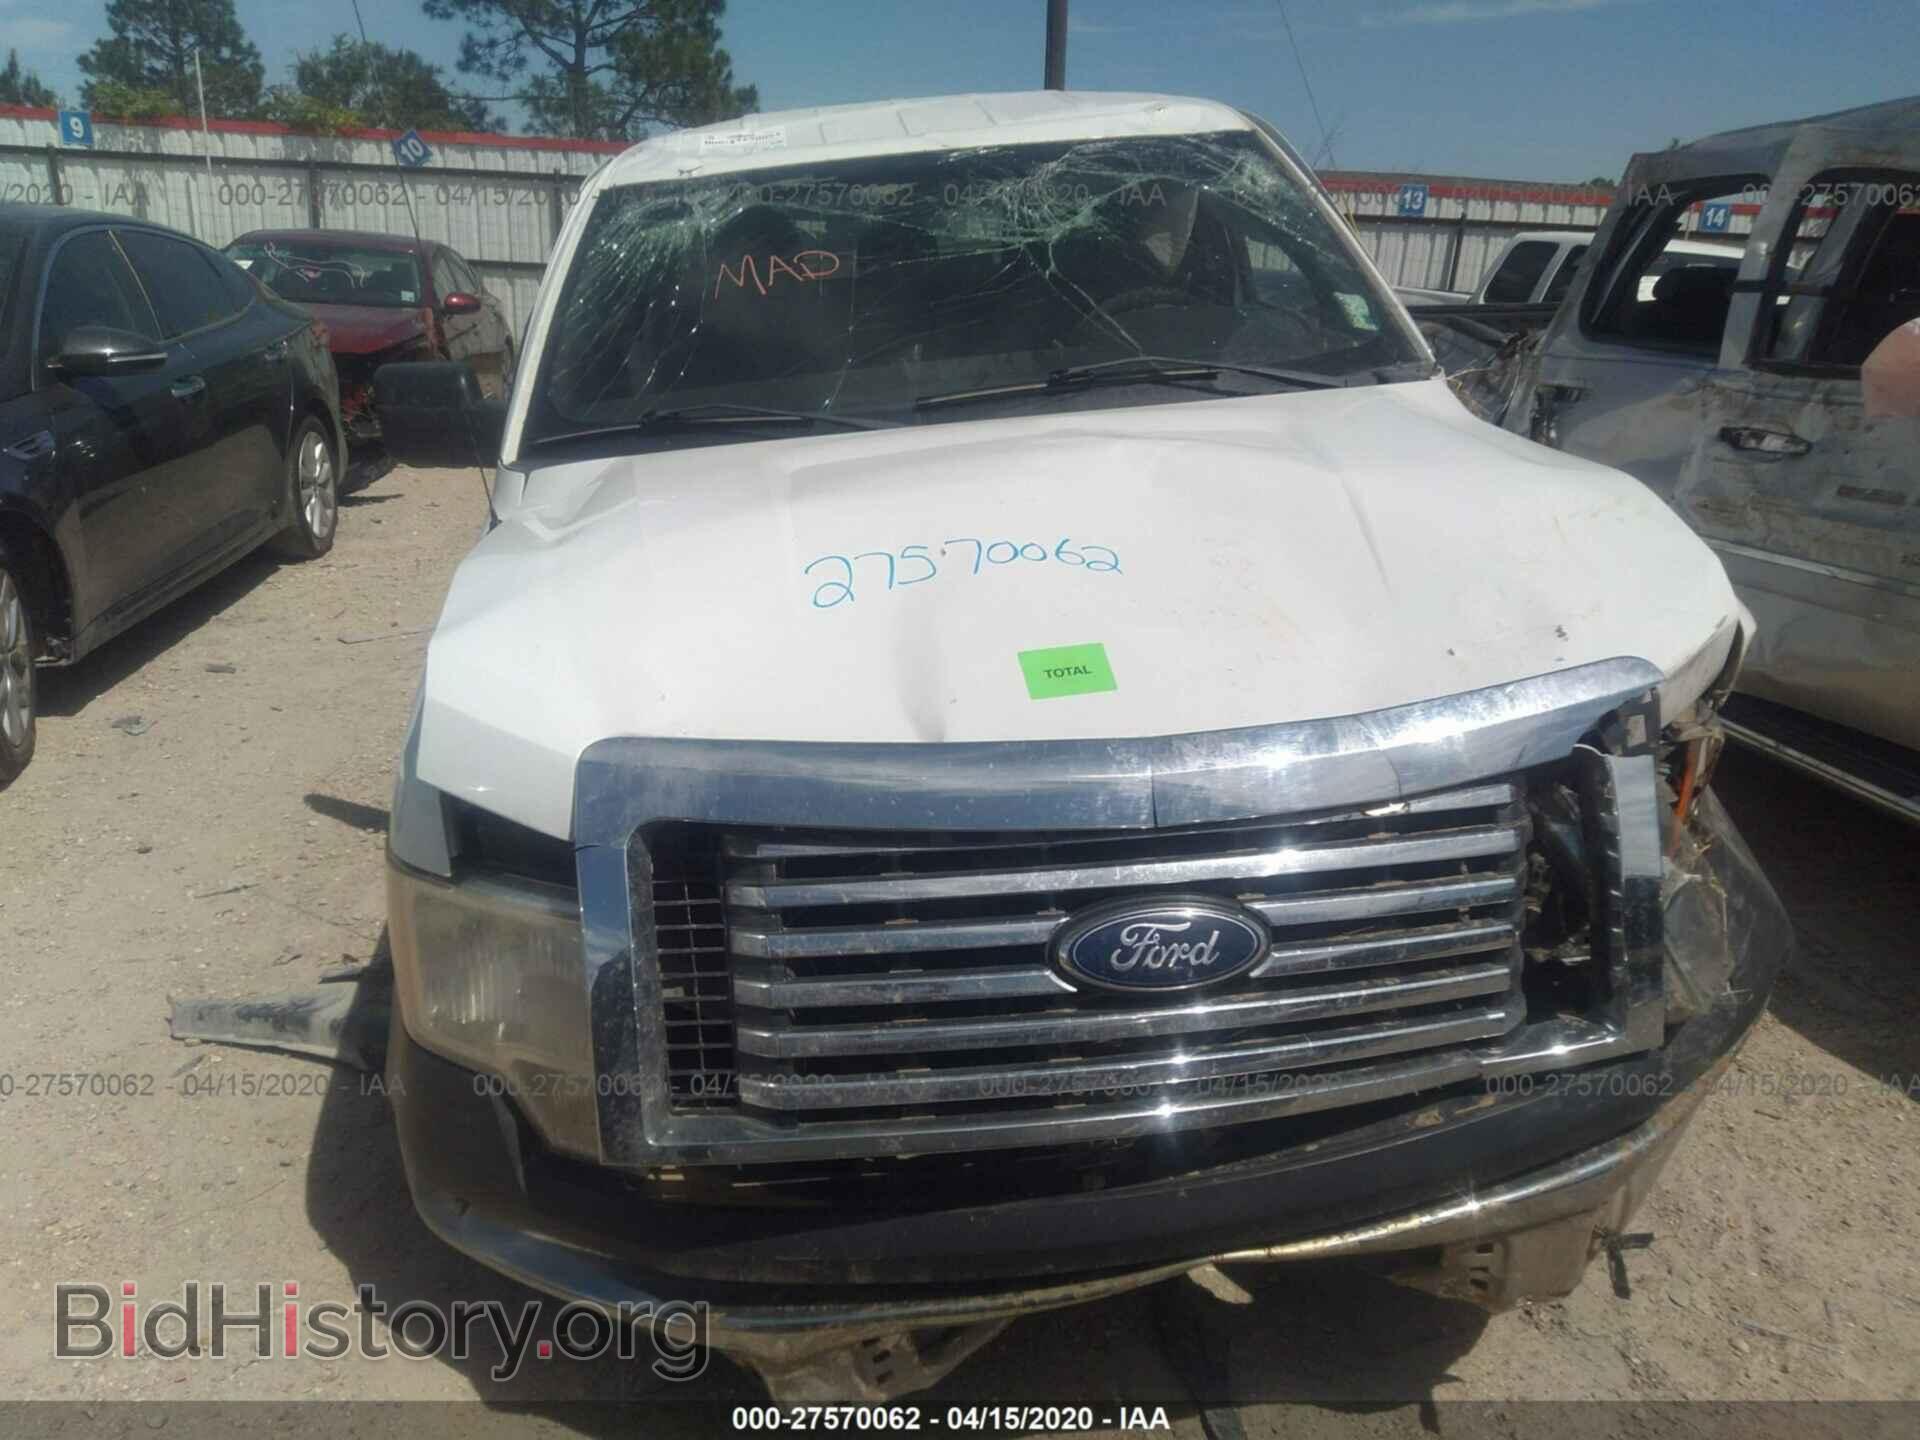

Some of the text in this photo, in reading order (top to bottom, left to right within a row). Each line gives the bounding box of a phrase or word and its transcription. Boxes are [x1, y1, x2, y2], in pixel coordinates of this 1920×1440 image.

[70, 116, 84, 138] 9
[400, 139, 424, 162] 10
[1403, 190, 1425, 210] 13
[1706, 207, 1726, 227] 14
[714, 250, 840, 300] MAD
[804, 538, 1123, 608] 27570062
[1044, 665, 1093, 679] TOTAL
[1110, 922, 1220, 972] Ford
